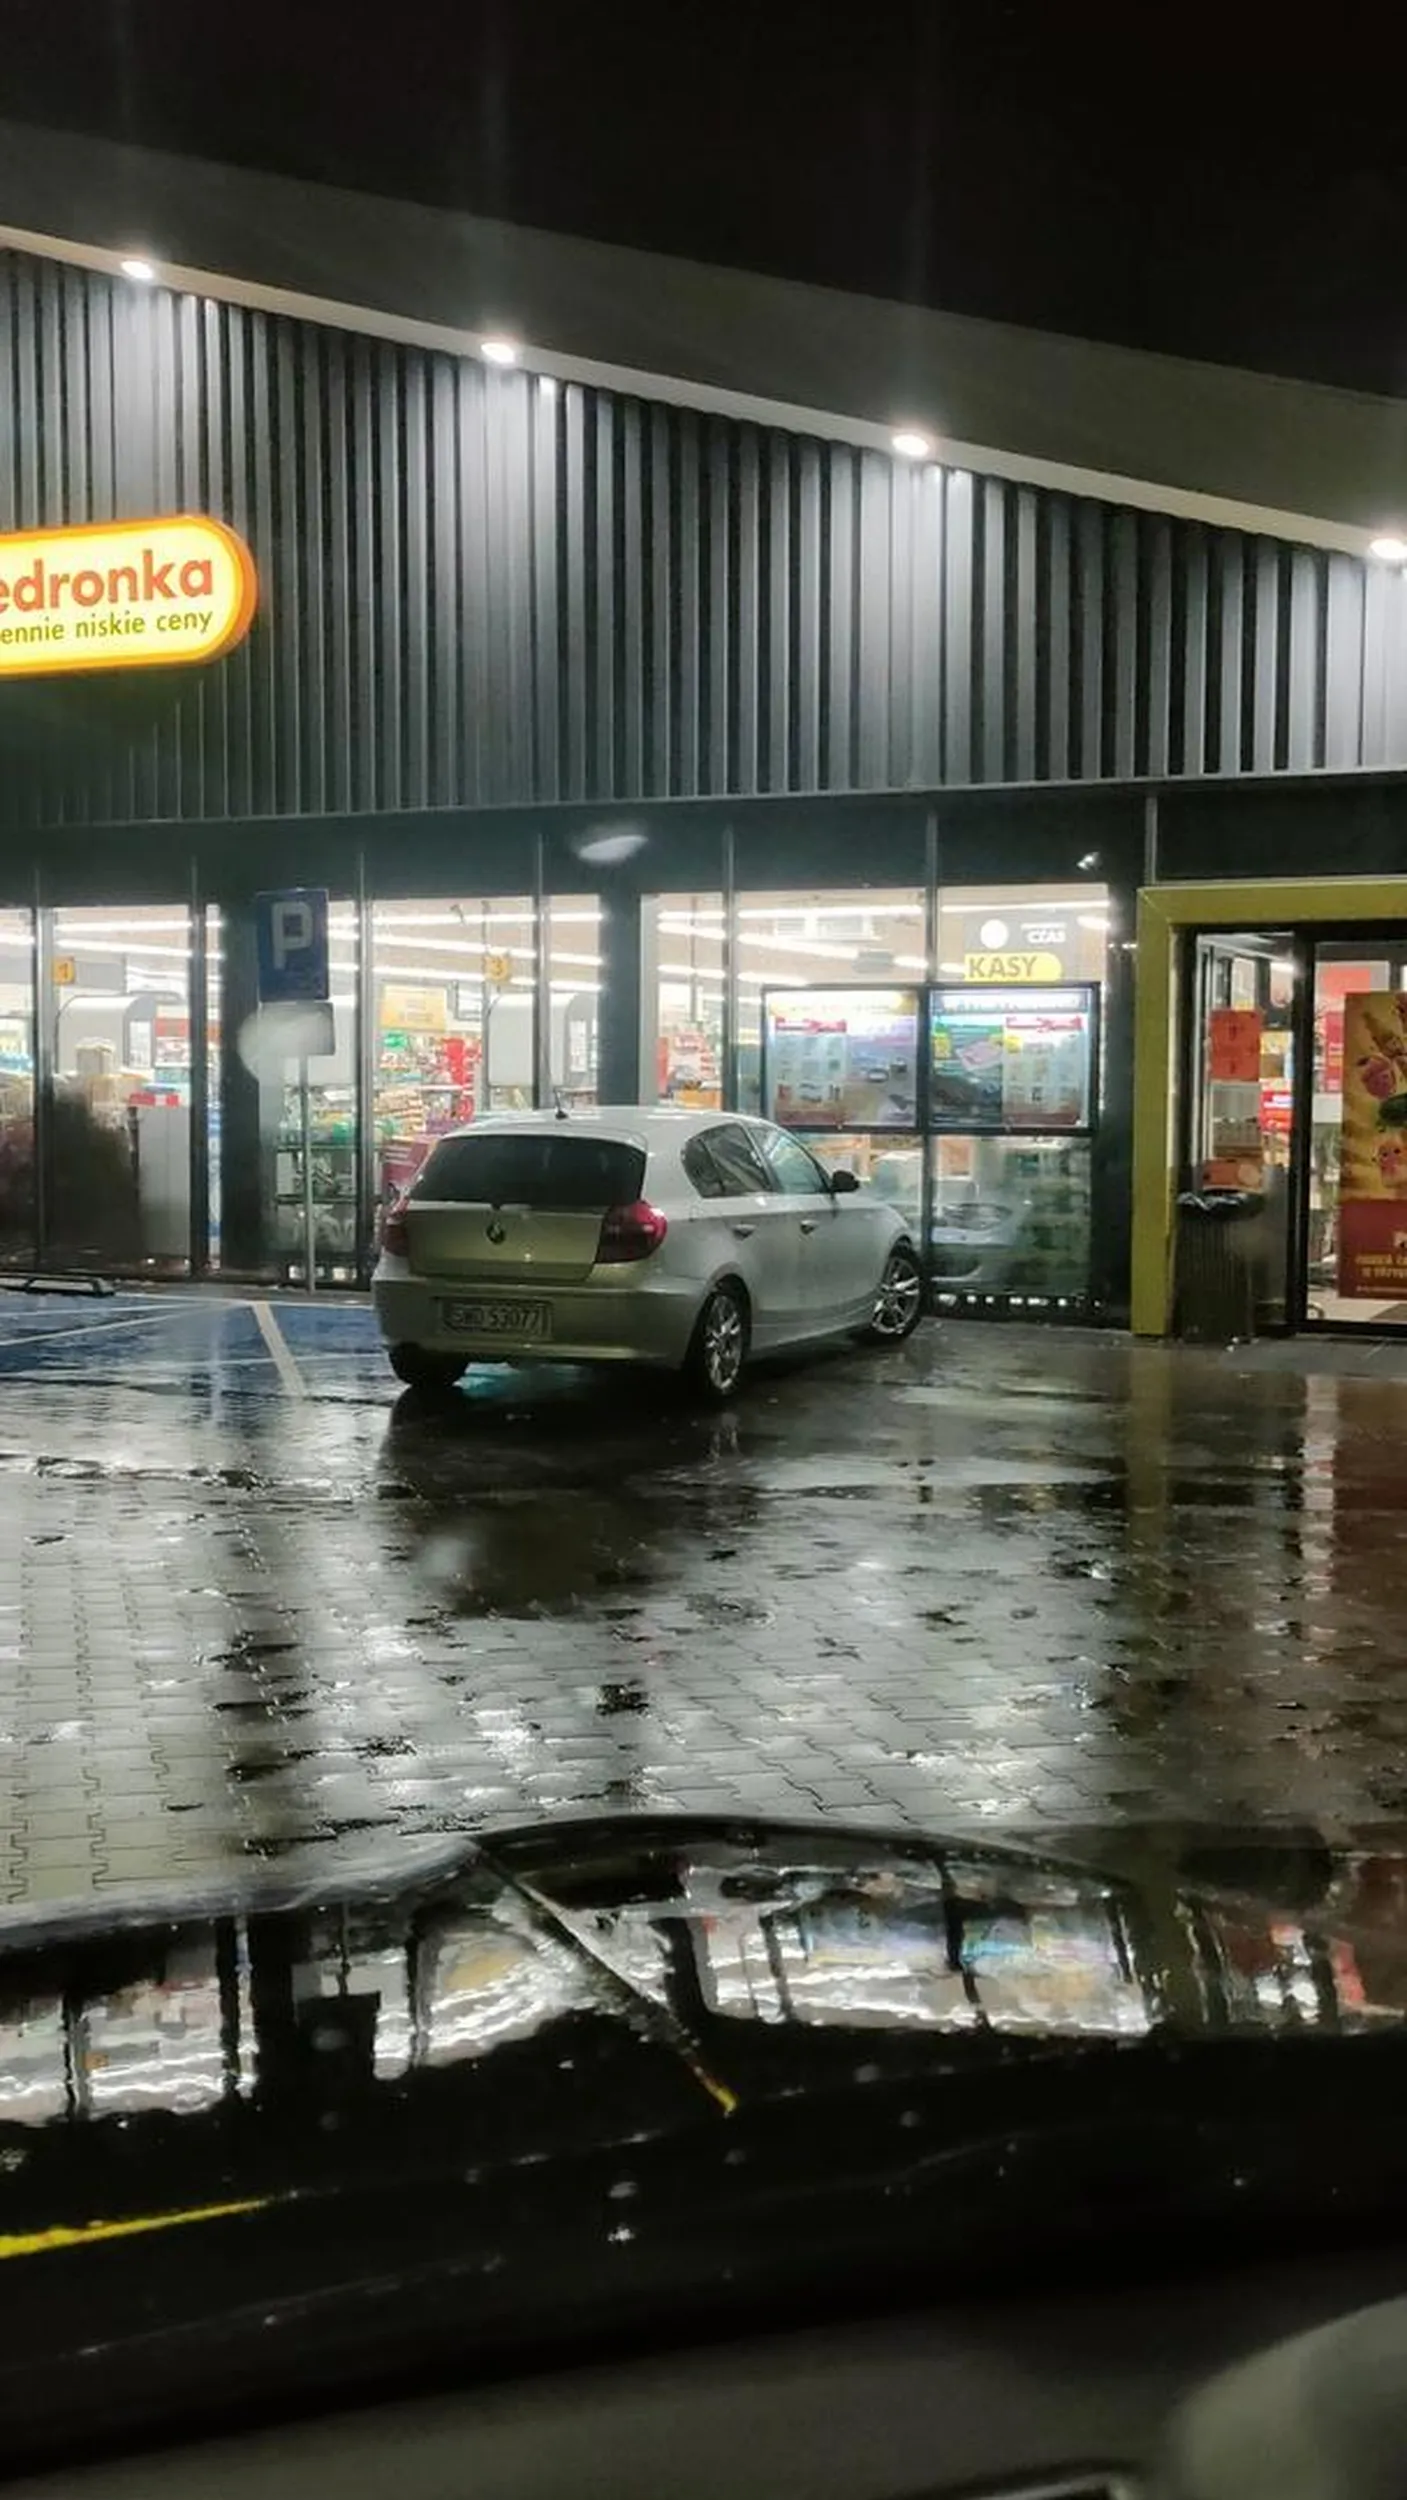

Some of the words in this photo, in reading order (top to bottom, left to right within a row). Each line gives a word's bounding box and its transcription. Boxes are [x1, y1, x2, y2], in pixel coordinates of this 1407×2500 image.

[75, 609, 145, 638] niskie
[156, 610, 213, 634] ceny
[272, 901, 313, 970] P
[968, 955, 1038, 979] KASY
